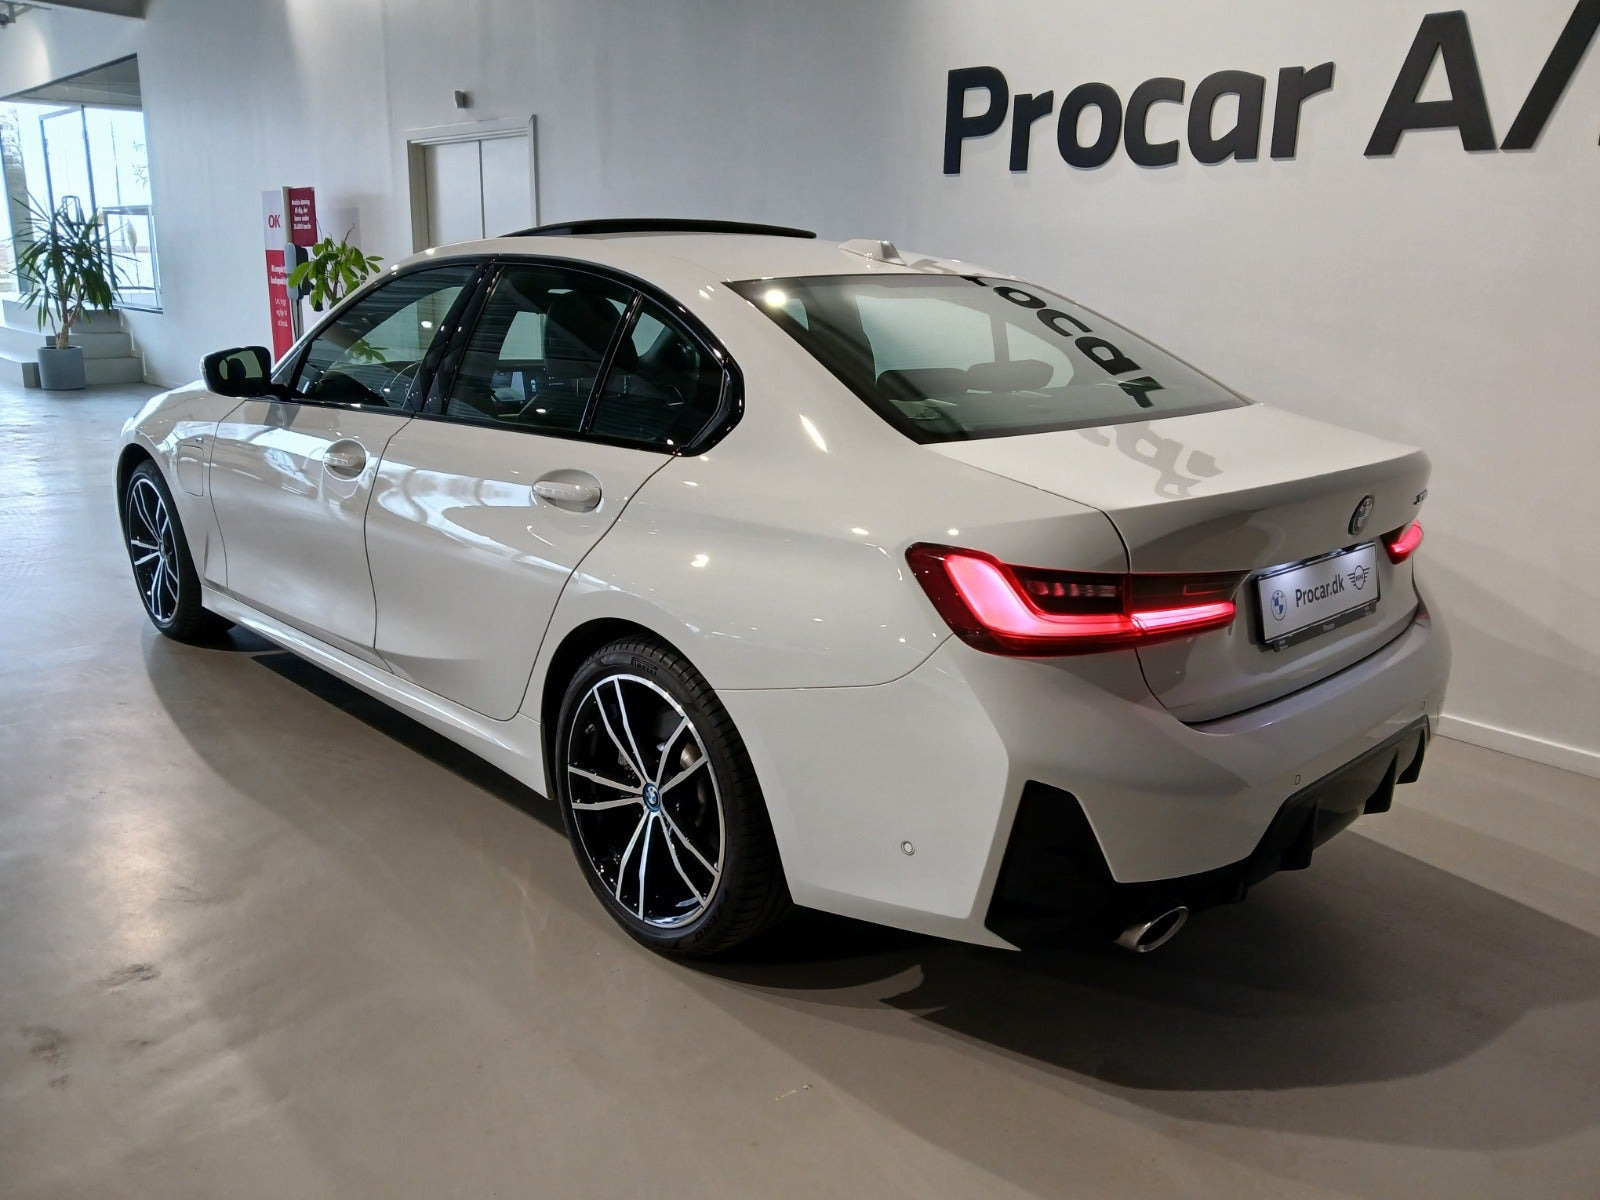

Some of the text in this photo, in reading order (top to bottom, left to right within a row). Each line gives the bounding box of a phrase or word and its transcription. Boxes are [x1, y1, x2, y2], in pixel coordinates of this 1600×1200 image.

[943, 0, 1600, 175] Procar A/
[268, 214, 281, 228] OK
[1295, 573, 1345, 607] Procar.dk
